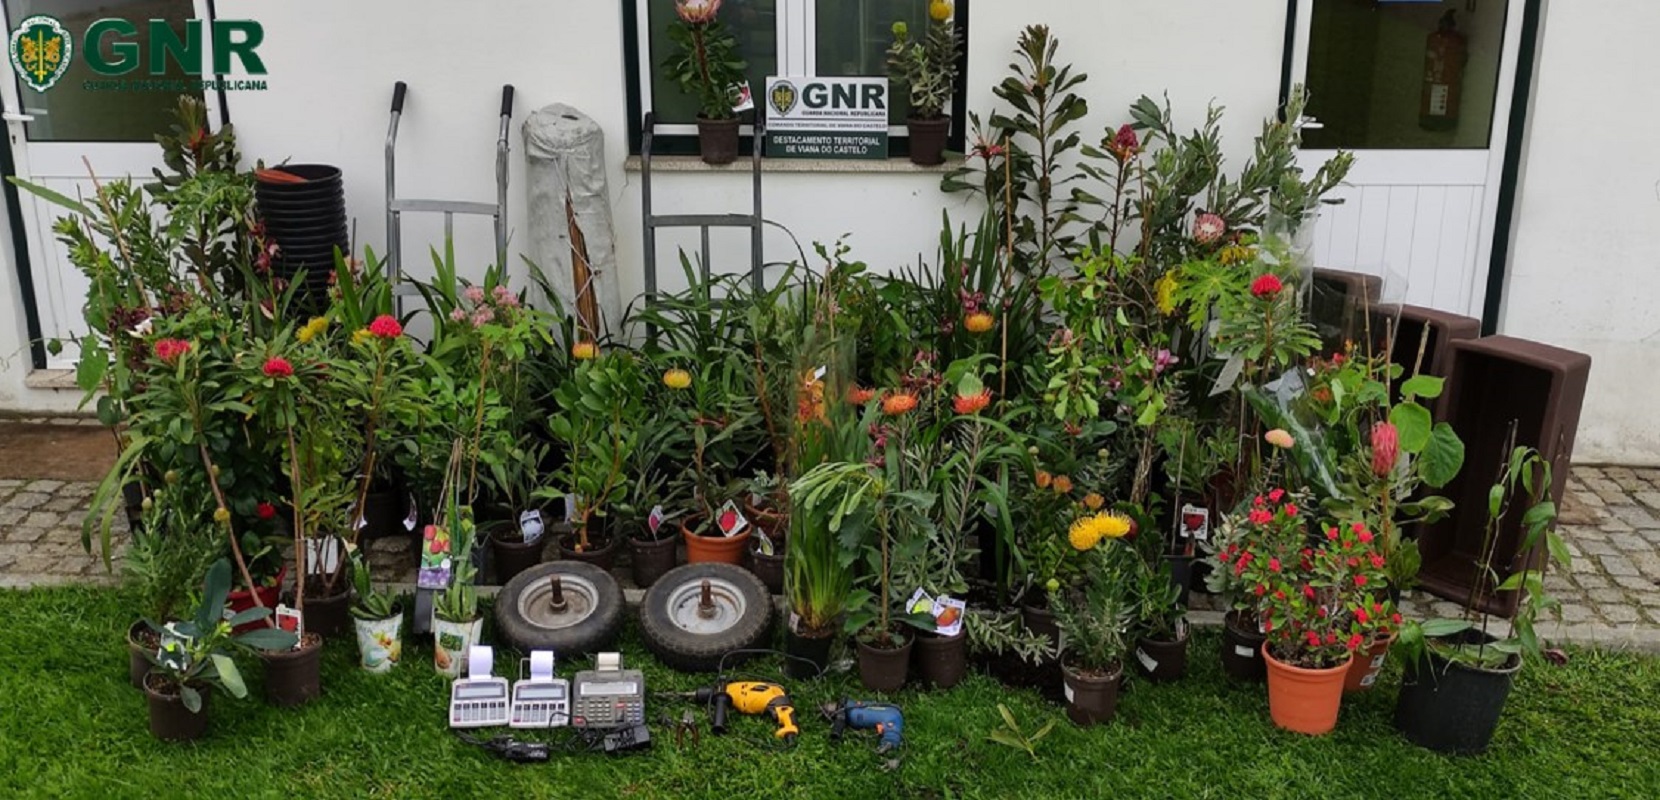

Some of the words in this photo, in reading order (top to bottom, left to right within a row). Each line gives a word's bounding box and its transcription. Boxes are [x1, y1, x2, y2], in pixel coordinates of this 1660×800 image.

[802, 83, 886, 109] GNR
[773, 135, 832, 144] DESTACAMENTO
[834, 136, 880, 146] TERRITORIAL
[786, 145, 796, 153] DE
[798, 145, 820, 153] VIANA
[834, 146, 868, 154] CASTELO
